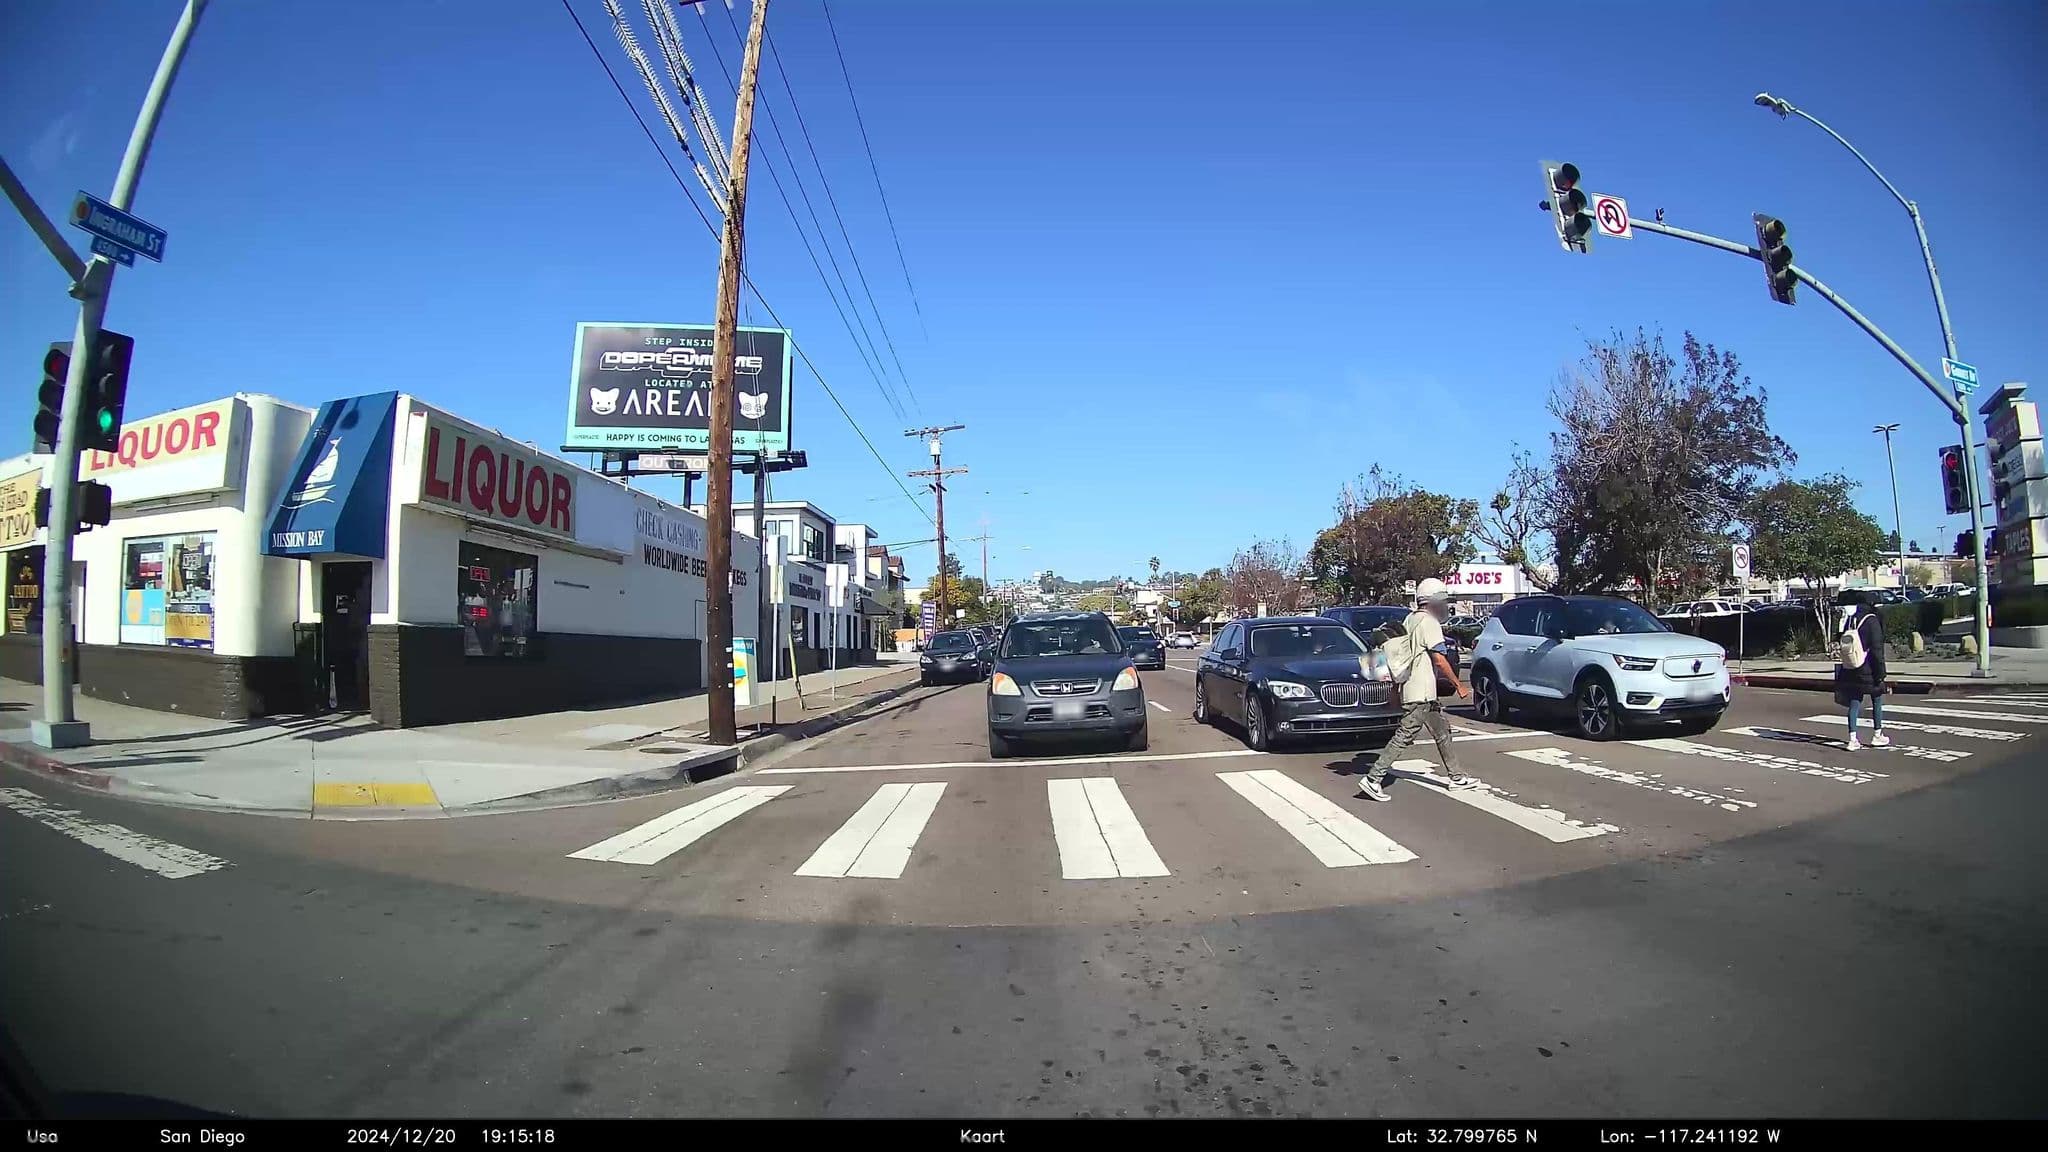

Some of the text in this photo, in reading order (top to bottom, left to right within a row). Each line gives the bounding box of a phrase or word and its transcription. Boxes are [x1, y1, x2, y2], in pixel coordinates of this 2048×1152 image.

[645, 338, 714, 347] STEP INSID
[645, 379, 693, 388] LOCATED
[622, 389, 712, 417] AREA
[606, 433, 635, 442] HAPPY
[638, 434, 645, 442] IS
[648, 434, 682, 443] COMING
[685, 435, 697, 443] TO
[425, 426, 571, 532] LIQUOR
[636, 507, 699, 552] CHECK CASHING
[272, 530, 325, 548] MISSION BAY
[643, 543, 689, 574] WORLDWIDE
[692, 558, 707, 578] BEE
[1466, 571, 1502, 585] JOE'S
